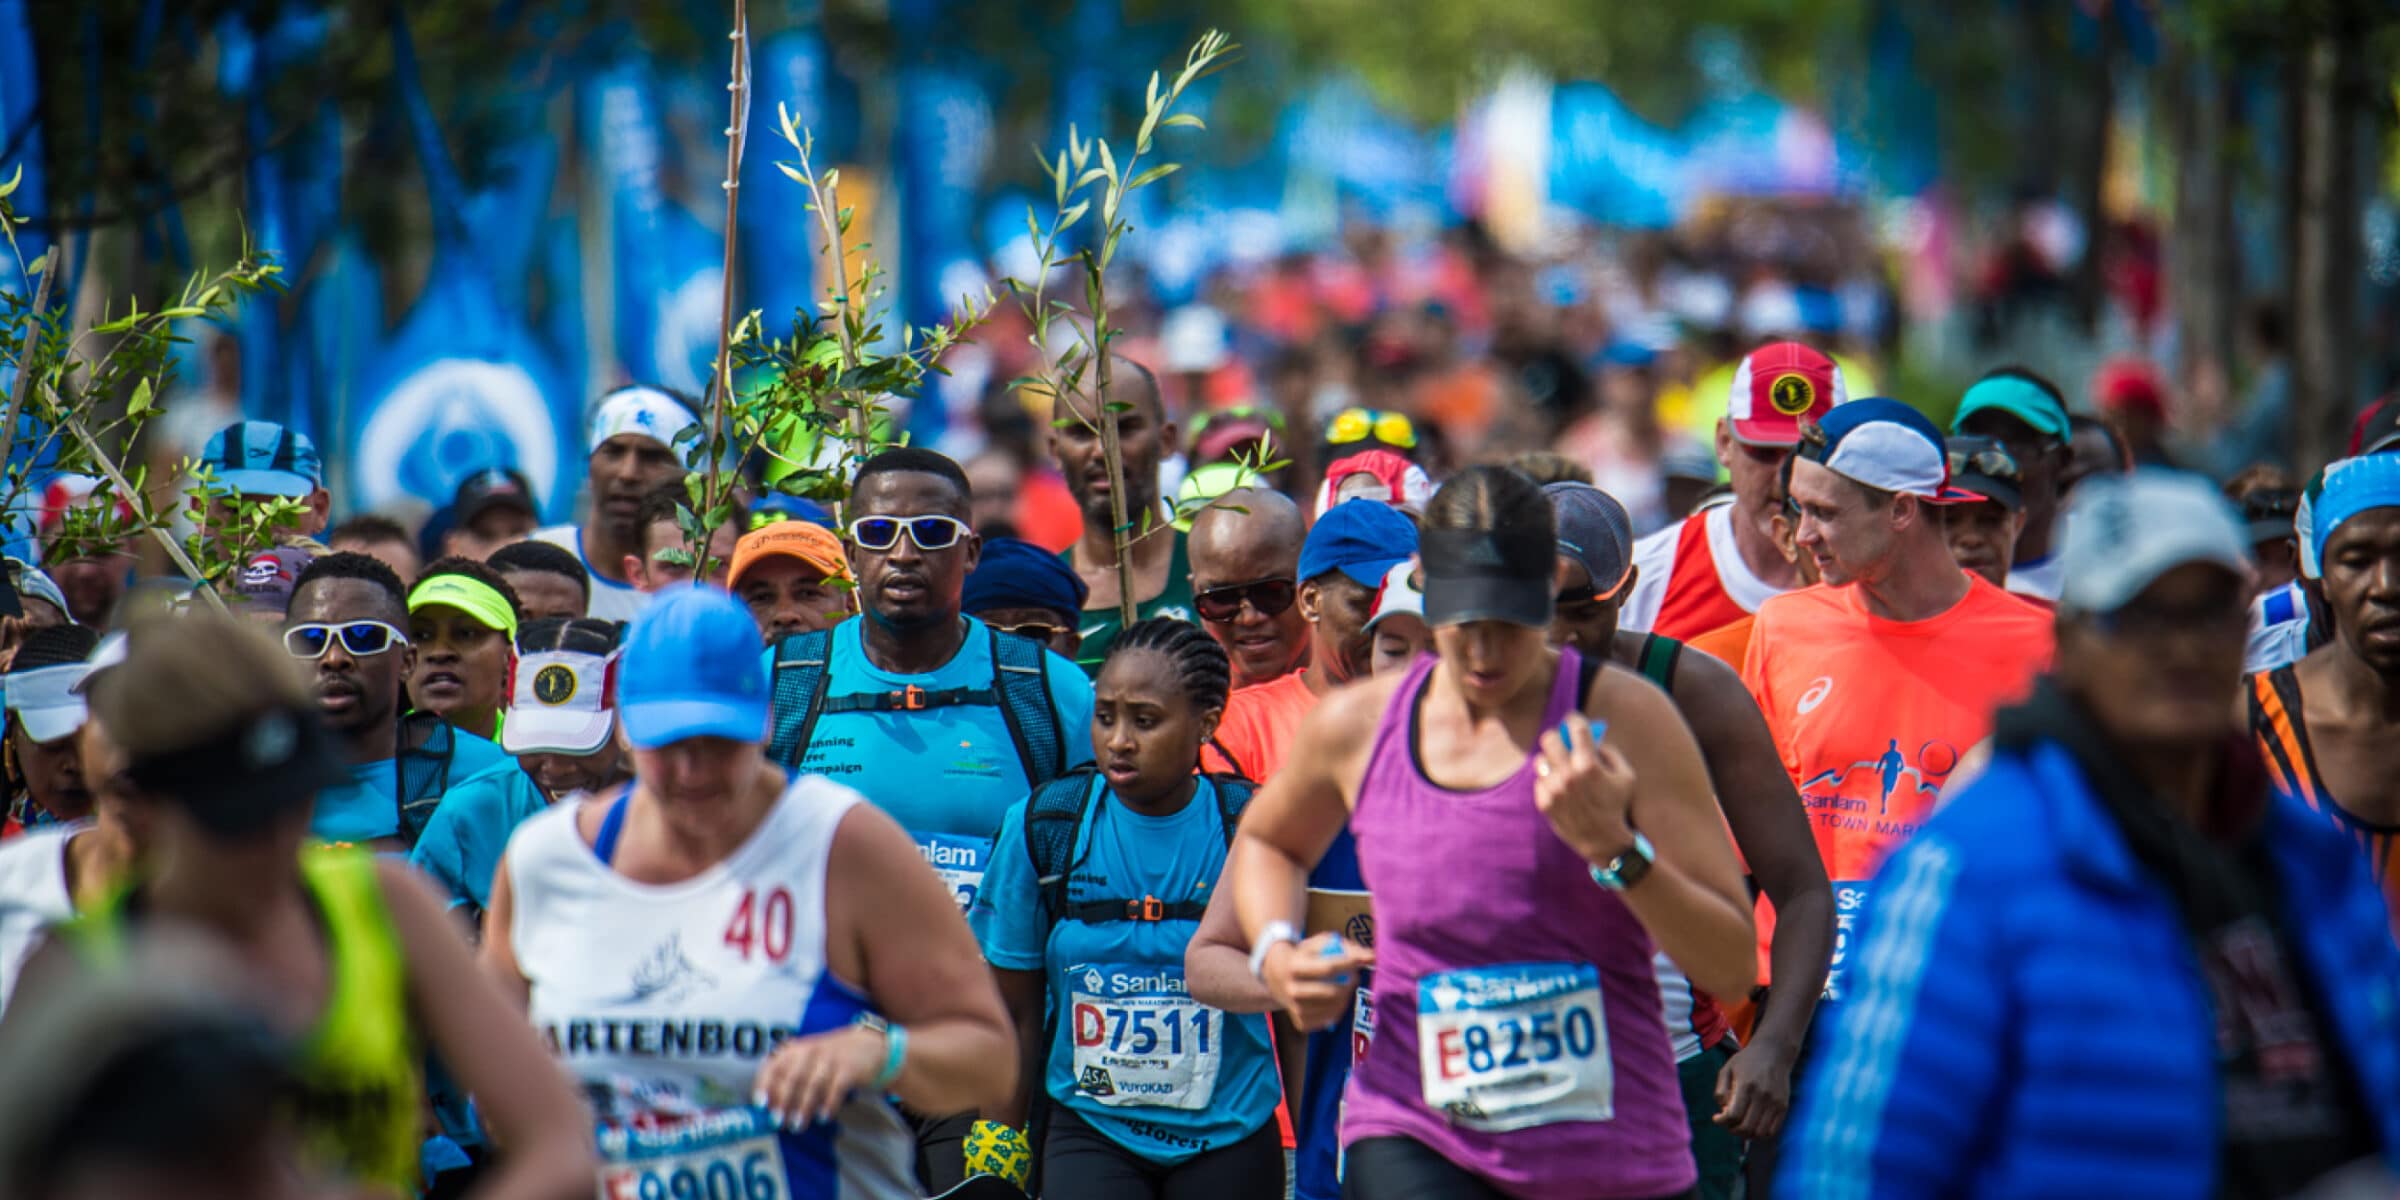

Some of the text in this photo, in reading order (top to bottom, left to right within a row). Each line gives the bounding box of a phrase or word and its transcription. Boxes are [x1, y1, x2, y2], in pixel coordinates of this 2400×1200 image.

[1801, 793, 1867, 813] Sanlam
[1820, 814, 1869, 831] TOWN
[916, 840, 976, 866] nlam
[723, 883, 795, 964] 40
[1074, 1003, 1210, 1056] D7511
[1438, 1005, 1597, 1080] E8250
